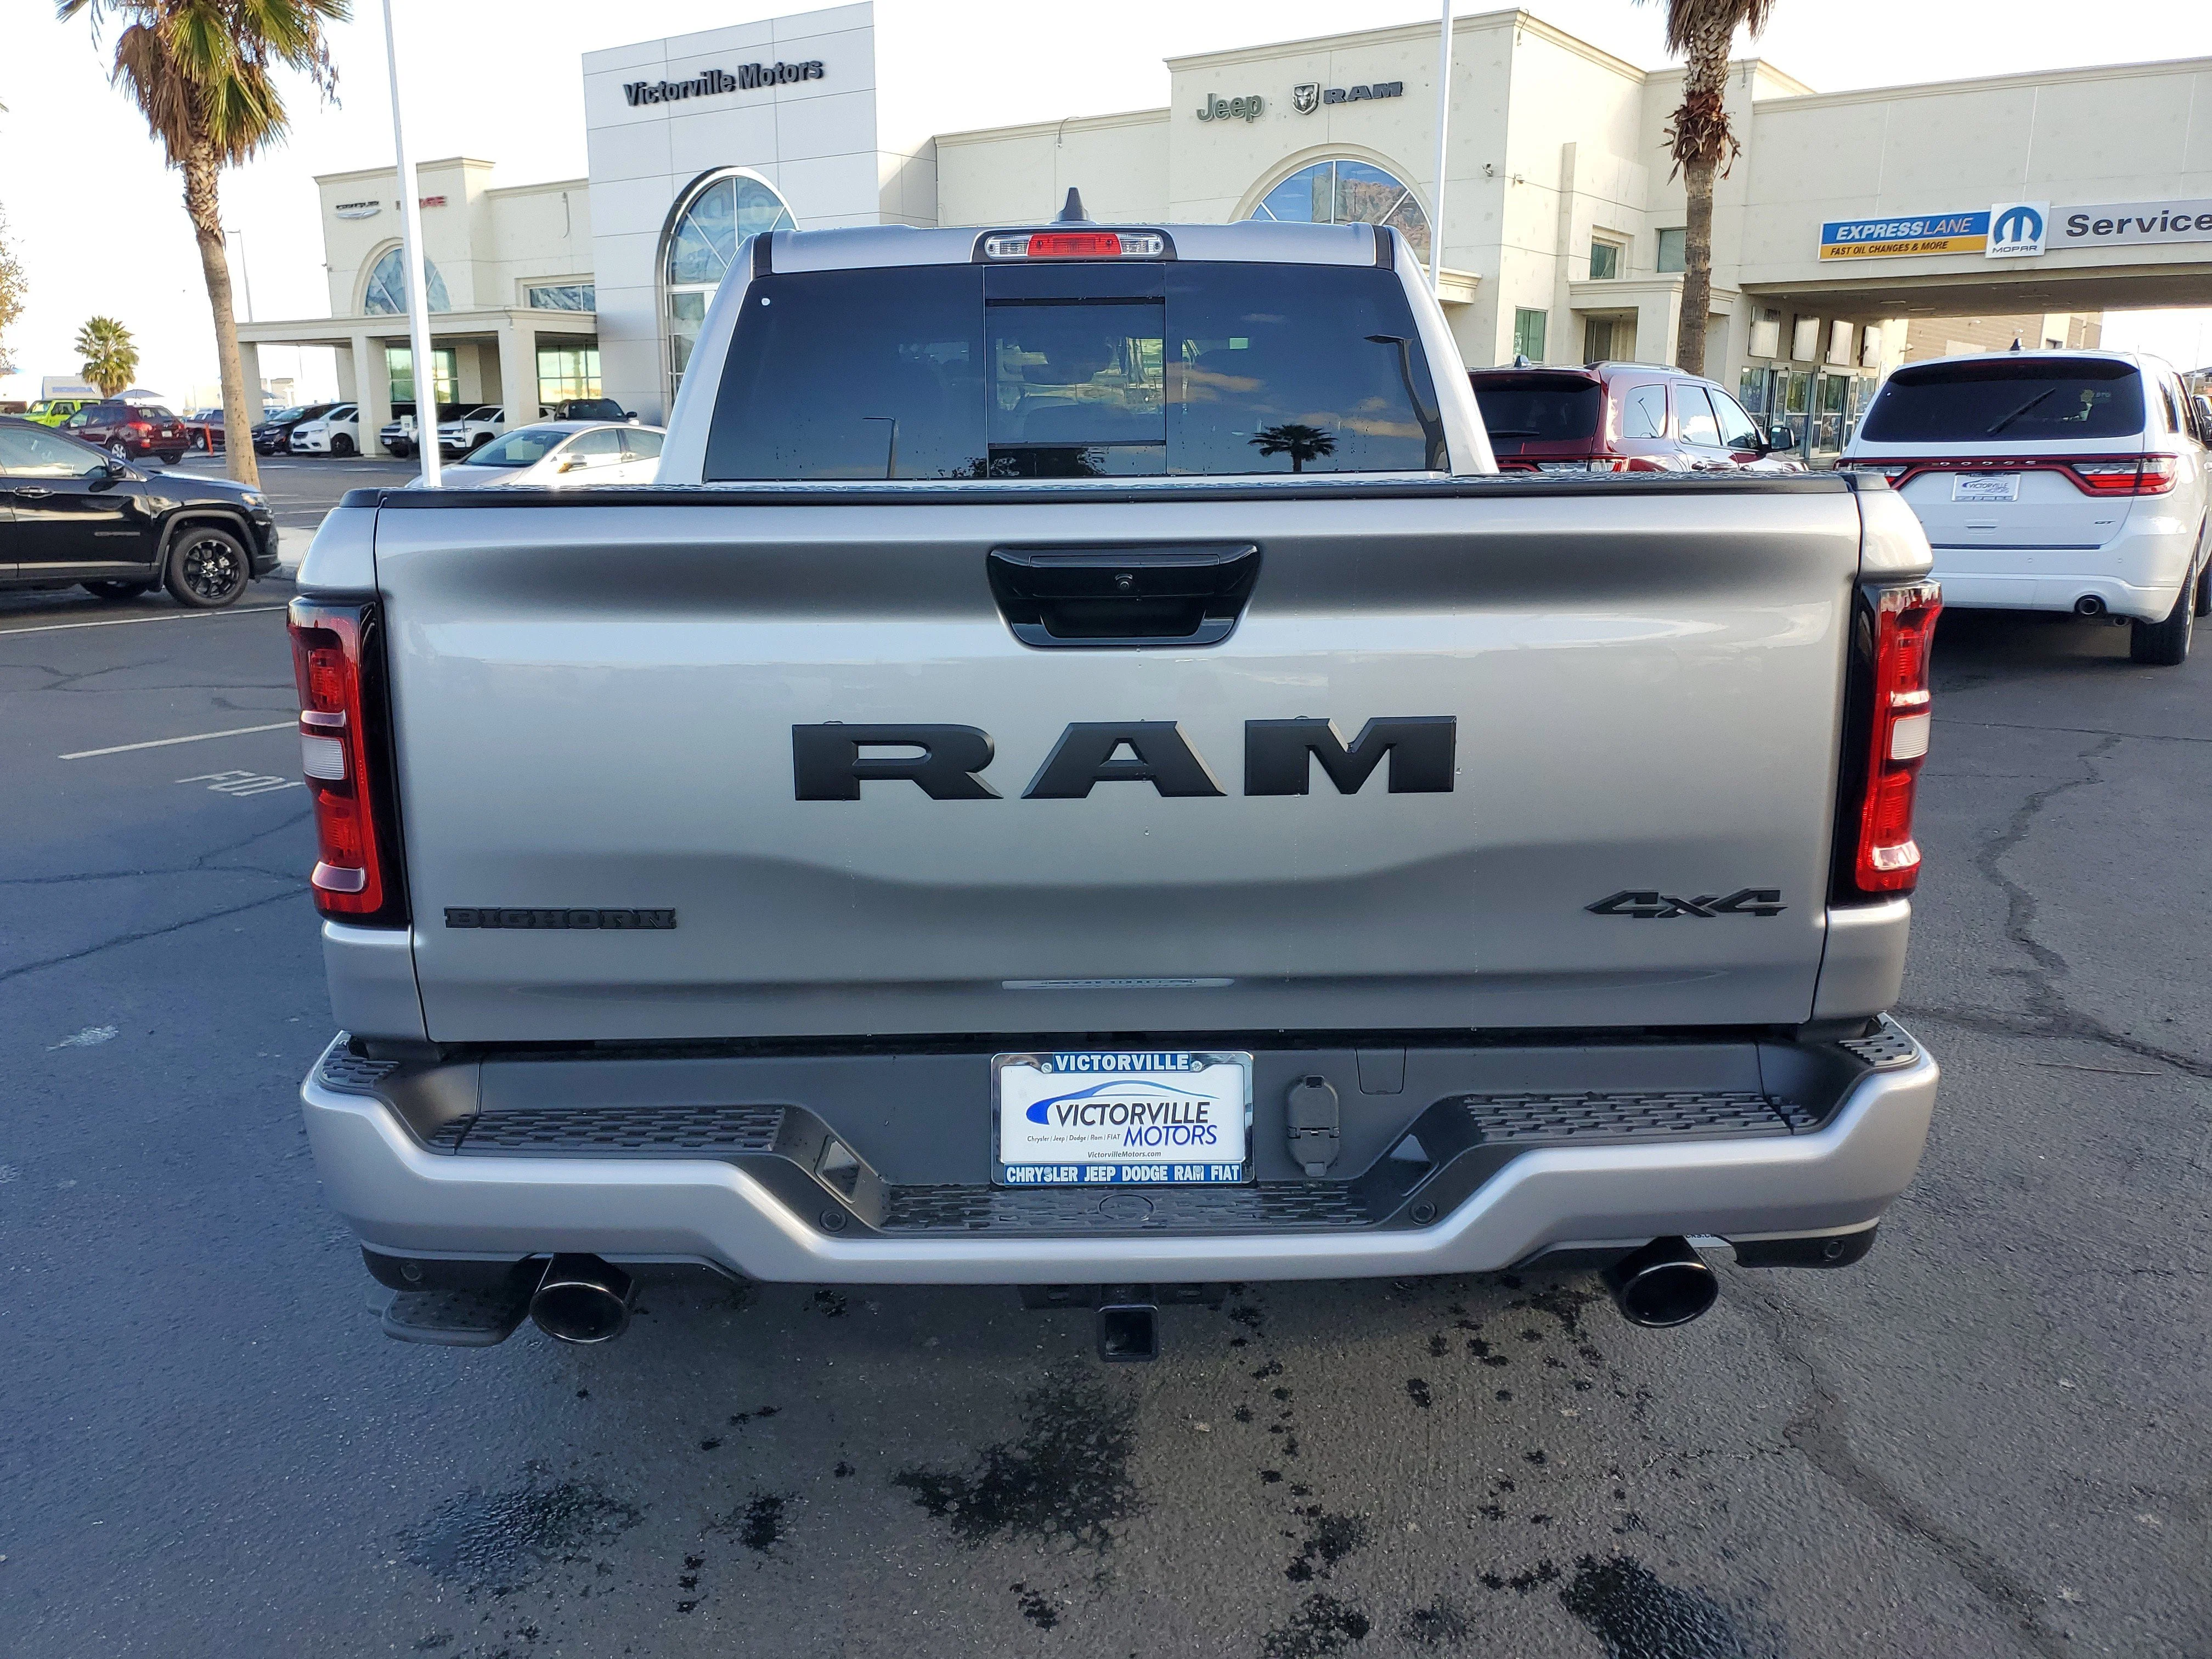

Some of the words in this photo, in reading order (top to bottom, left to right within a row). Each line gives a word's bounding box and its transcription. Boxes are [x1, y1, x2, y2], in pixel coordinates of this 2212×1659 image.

[623, 70, 736, 106] Victorville
[738, 60, 823, 89] Motors
[1323, 81, 1403, 105] RAM
[1197, 93, 1265, 122] Jeep
[2066, 210, 2212, 237] Service
[1830, 246, 1853, 256] FAST
[1853, 245, 1866, 255] OIL
[1869, 243, 1909, 253] CHANGES
[1910, 242, 1918, 251] &
[1921, 241, 1949, 251] MORE
[1992, 245, 2038, 253] MOPAR
[792, 715, 1456, 800] RAM
[1054, 1054, 1189, 1071] VICTORVILLE
[1056, 1102, 1211, 1127] VICTORVILLE
[1027, 1135, 1049, 1143] Chrysler
[1053, 1135, 1065, 1143] Jeep
[1124, 1125, 1217, 1147] MOTORS
[1087, 1150, 1161, 1158] VictorvilleMotors.com
[1006, 1167, 1078, 1182] CHRYSLER
[1084, 1166, 1116, 1181] JEEP
[1122, 1166, 1168, 1181] DODGE
[1174, 1165, 1204, 1180] RAM
[1211, 1165, 1239, 1180] FIAT
